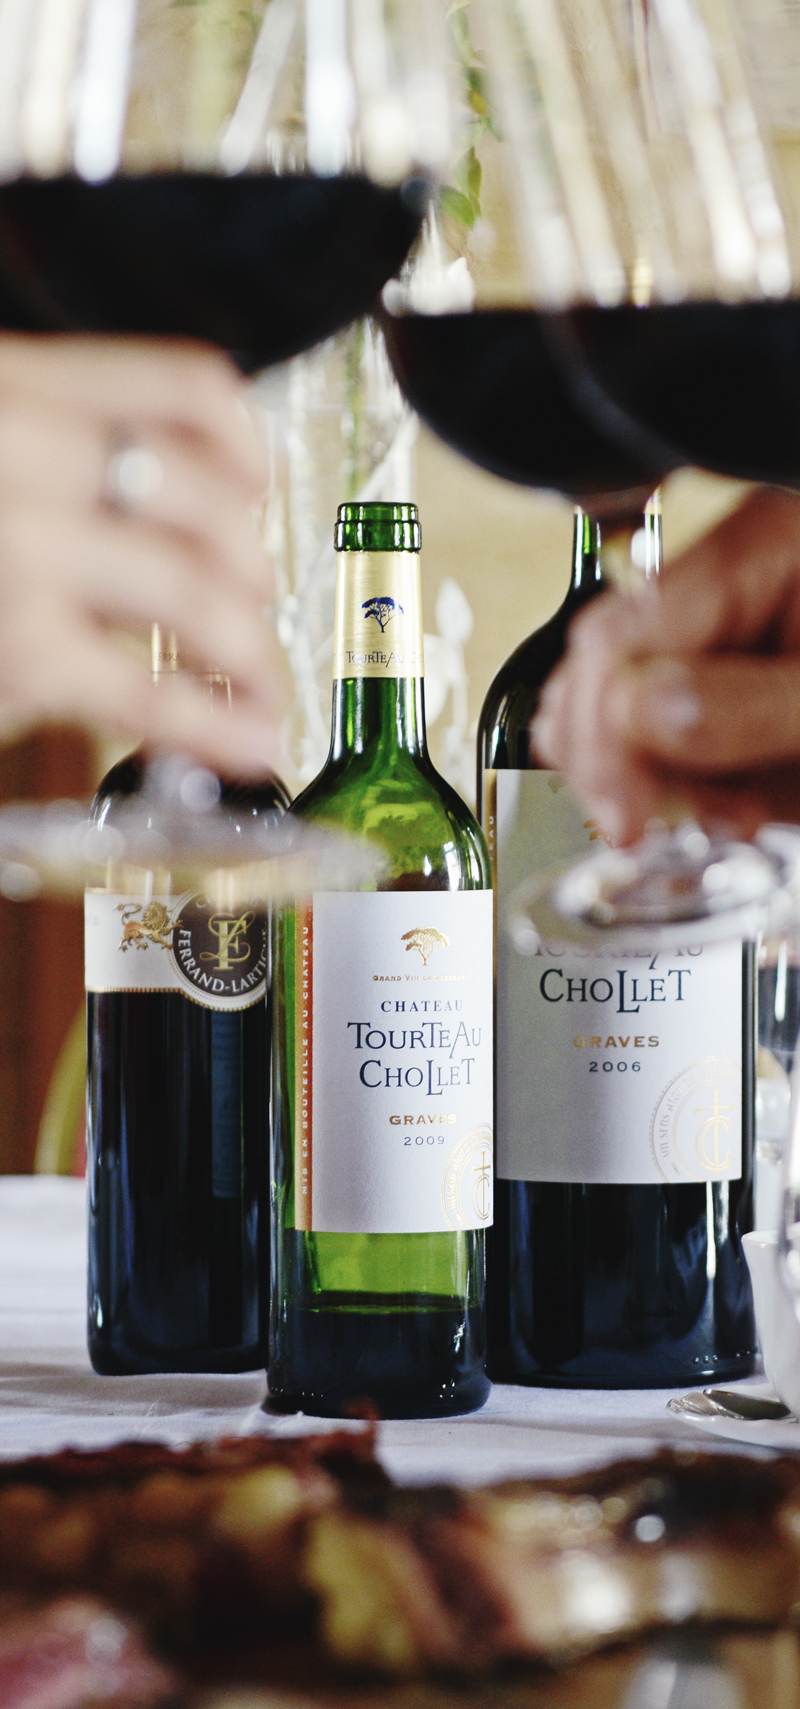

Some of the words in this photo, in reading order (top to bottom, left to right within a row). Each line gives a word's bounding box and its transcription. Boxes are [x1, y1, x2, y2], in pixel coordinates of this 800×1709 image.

[178, 929, 266, 992] FERRAND-LARTI
[380, 999, 463, 1013] CHATEAU
[302, 1009, 309, 1030] AU
[573, 1035, 660, 1049] GRAVES
[588, 1060, 642, 1073] 2006
[389, 1114, 457, 1126] GRAVES
[302, 1138, 309, 1158] EN
[403, 1135, 446, 1147] 2009
